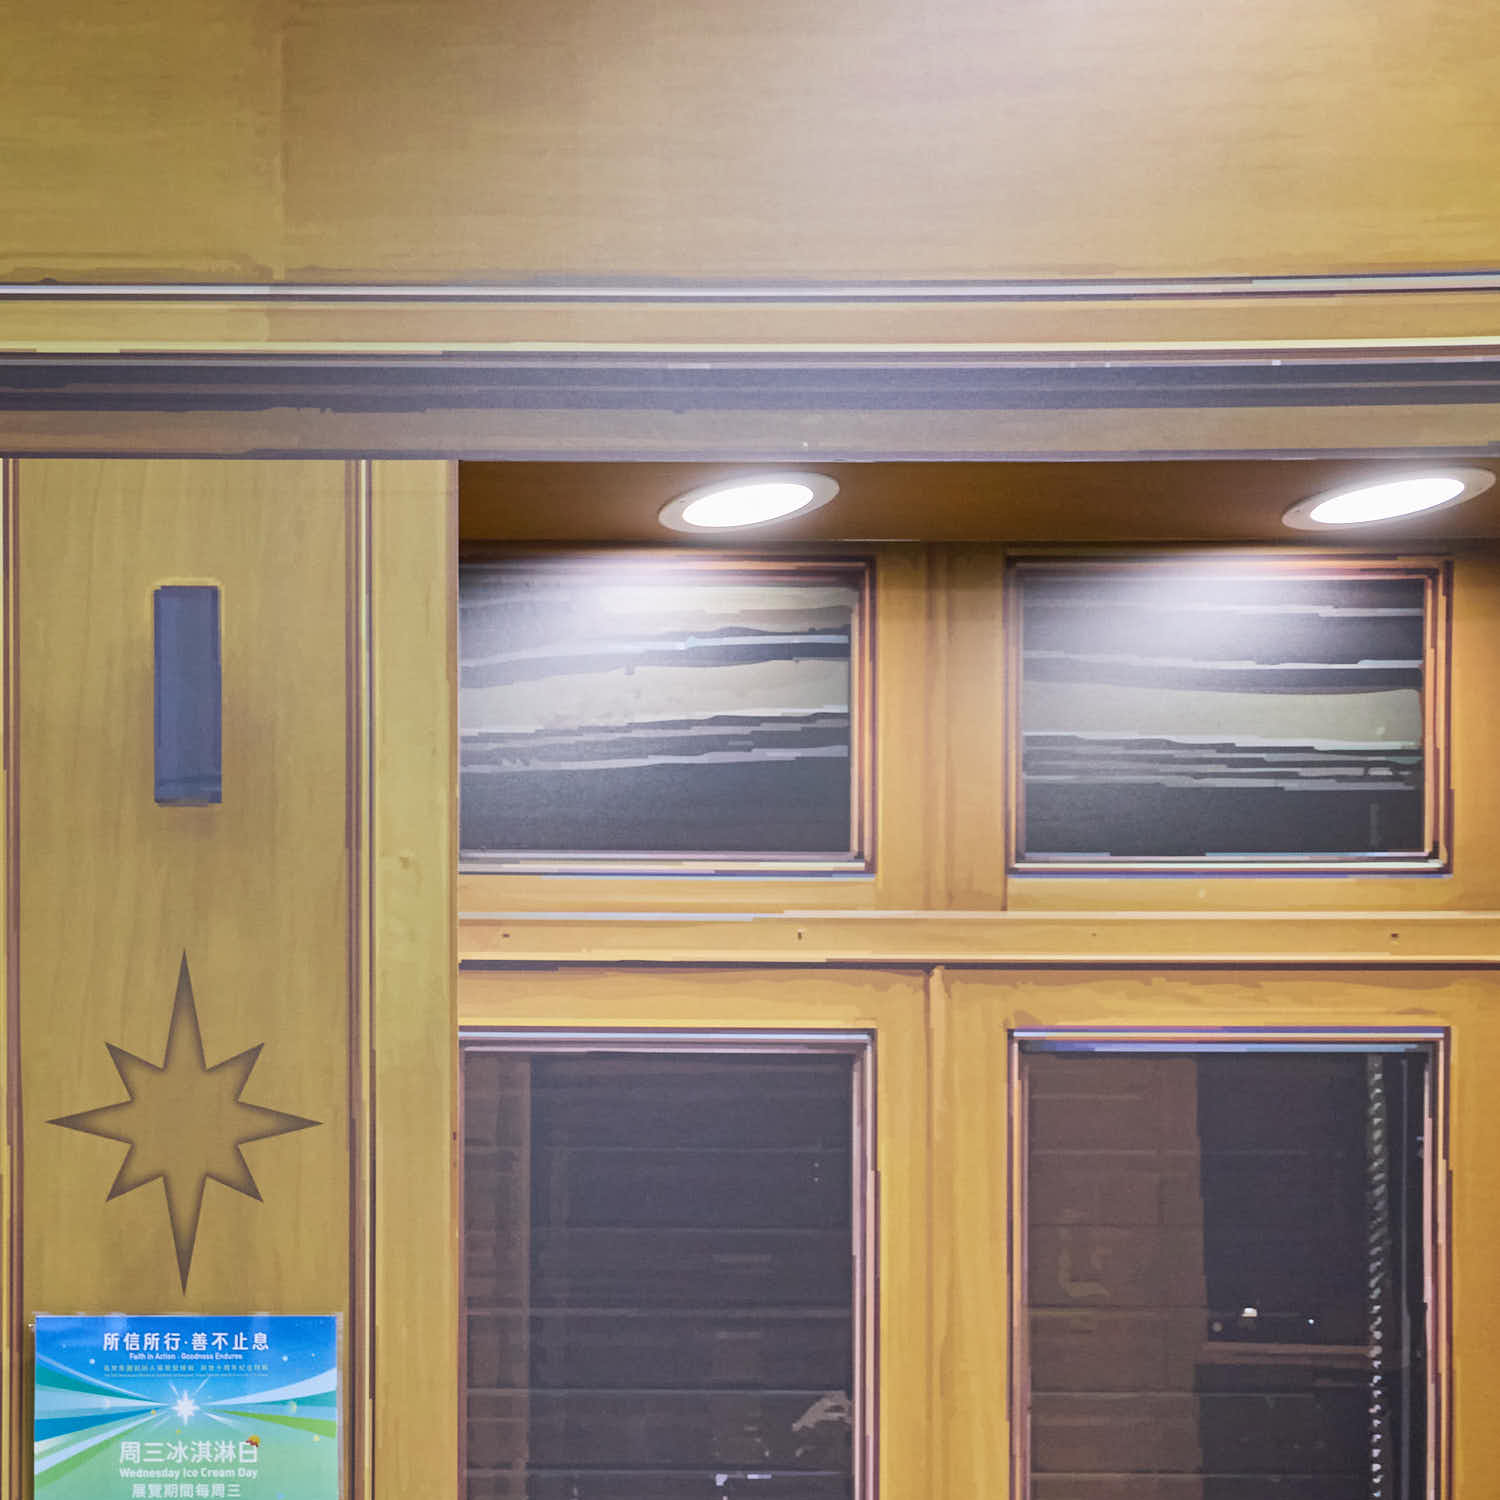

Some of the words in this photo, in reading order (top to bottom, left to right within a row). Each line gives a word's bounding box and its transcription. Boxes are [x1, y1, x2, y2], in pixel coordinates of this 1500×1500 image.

[119, 1440, 258, 1464] 周三冰淇淋日
[119, 1467, 180, 1479] Wednesday
[183, 1467, 199, 1478] Ice
[201, 1467, 236, 1478] Cream
[238, 1467, 258, 1479] Day
